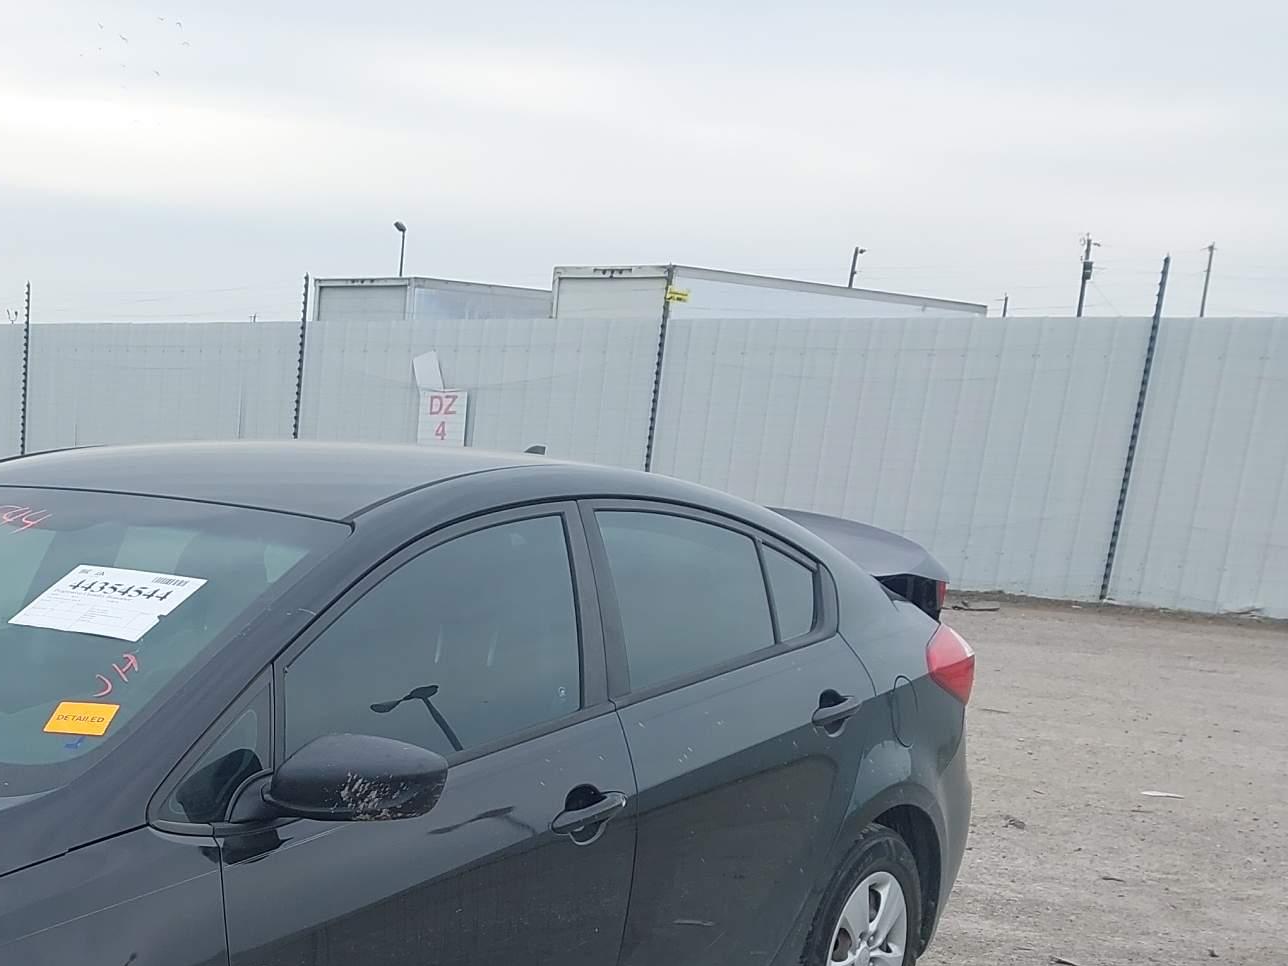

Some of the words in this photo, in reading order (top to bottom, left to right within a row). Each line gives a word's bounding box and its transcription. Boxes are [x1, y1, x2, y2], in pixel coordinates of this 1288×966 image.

[429, 395, 458, 416] DZ
[435, 420, 447, 440] 4
[69, 578, 174, 602] 44354544
[56, 714, 105, 723] DETAILED
